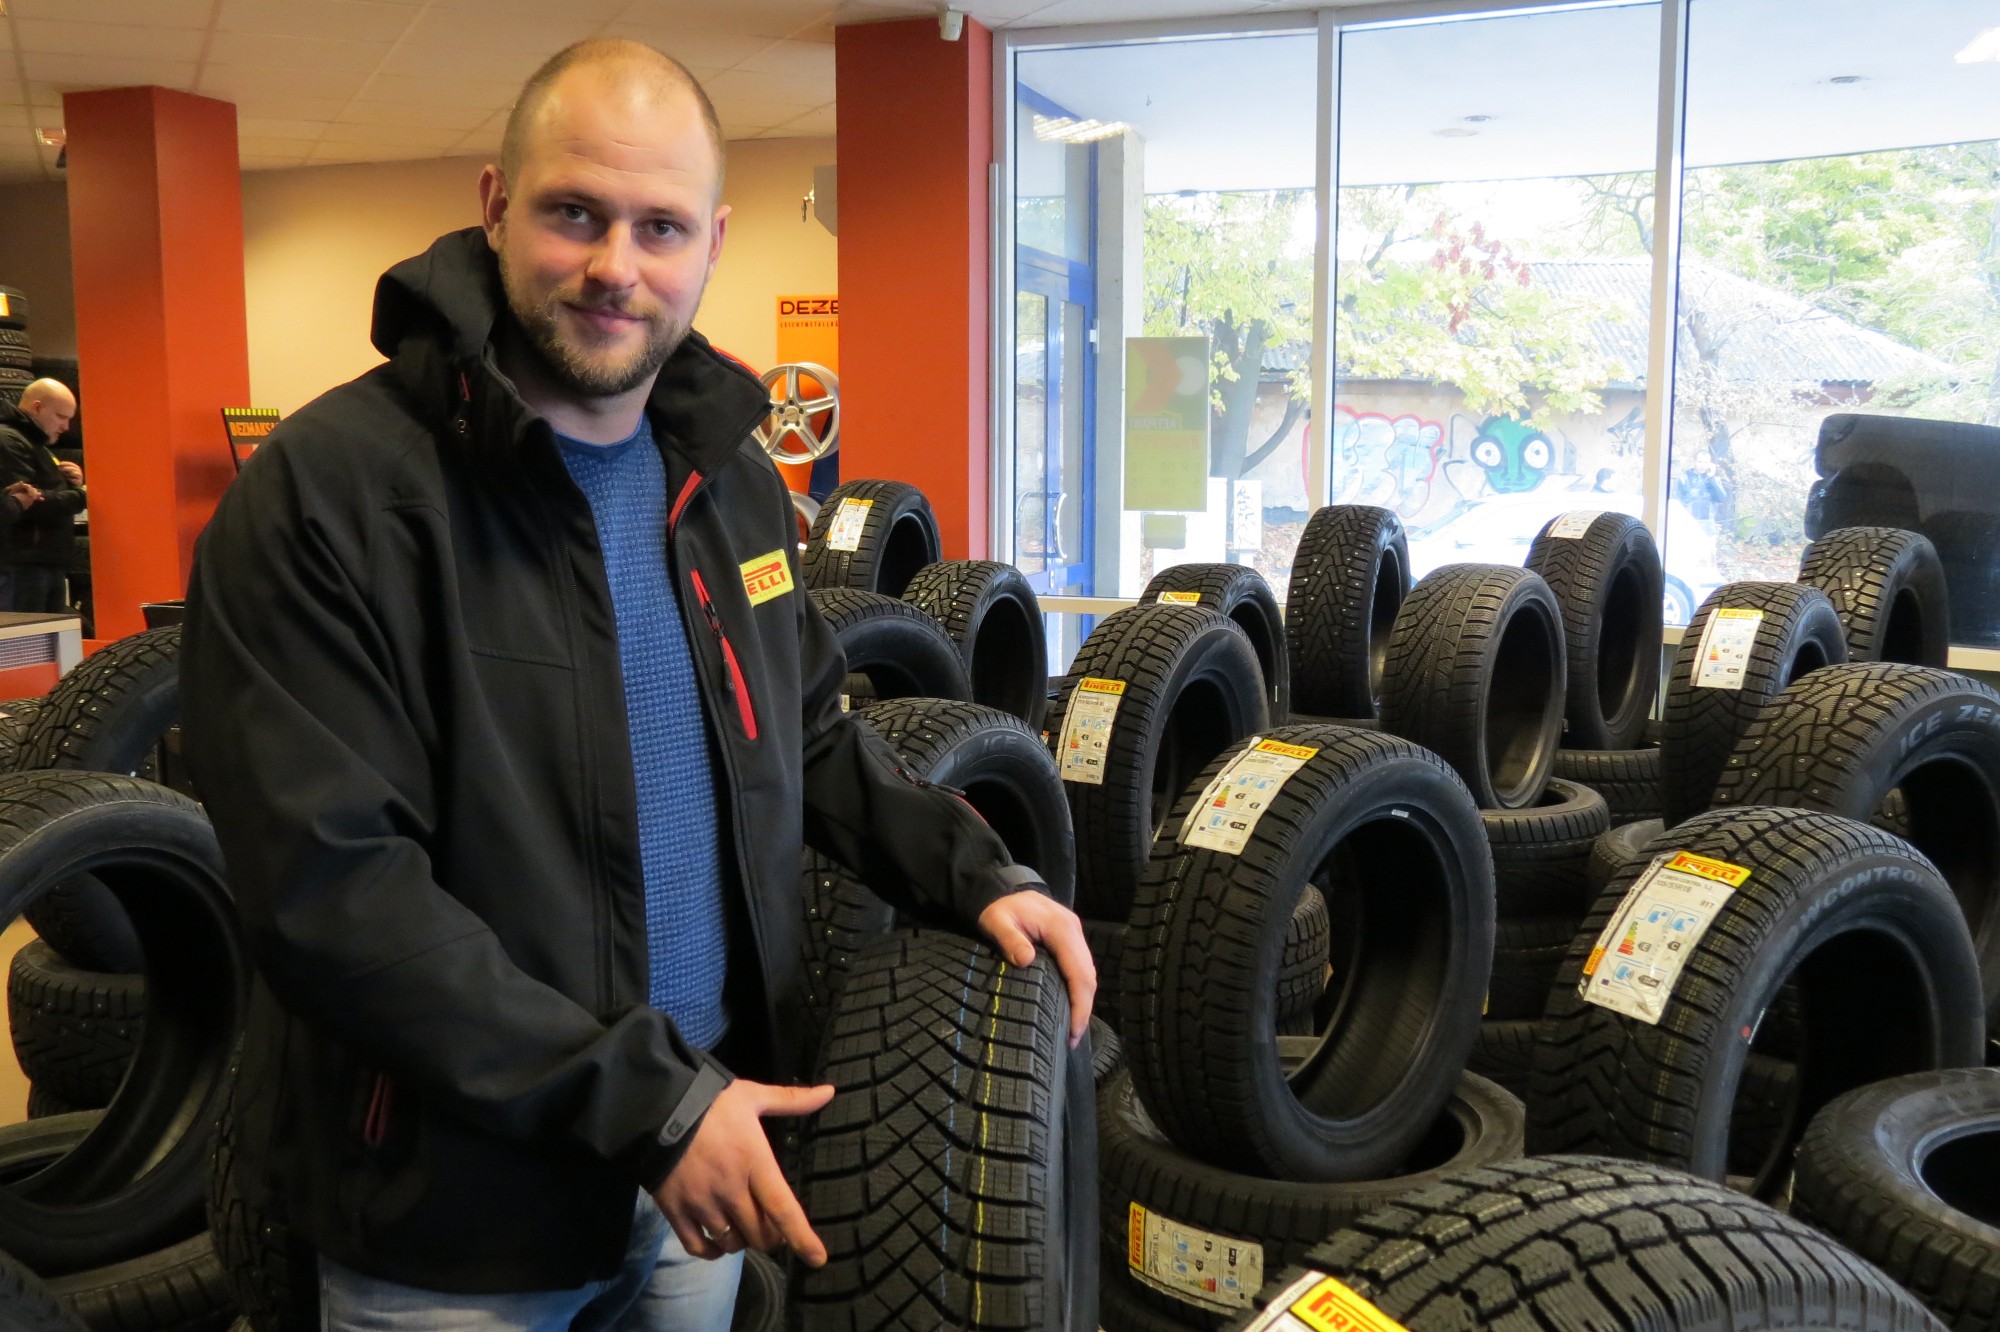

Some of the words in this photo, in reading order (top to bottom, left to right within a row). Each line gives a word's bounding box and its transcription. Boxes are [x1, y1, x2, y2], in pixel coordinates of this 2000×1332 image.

[1084, 680, 1121, 692] PIRELLI
[1900, 711, 1942, 757] ICE
[1261, 743, 1313, 758] PIRELLI
[1674, 855, 1741, 881] PIRELLI
